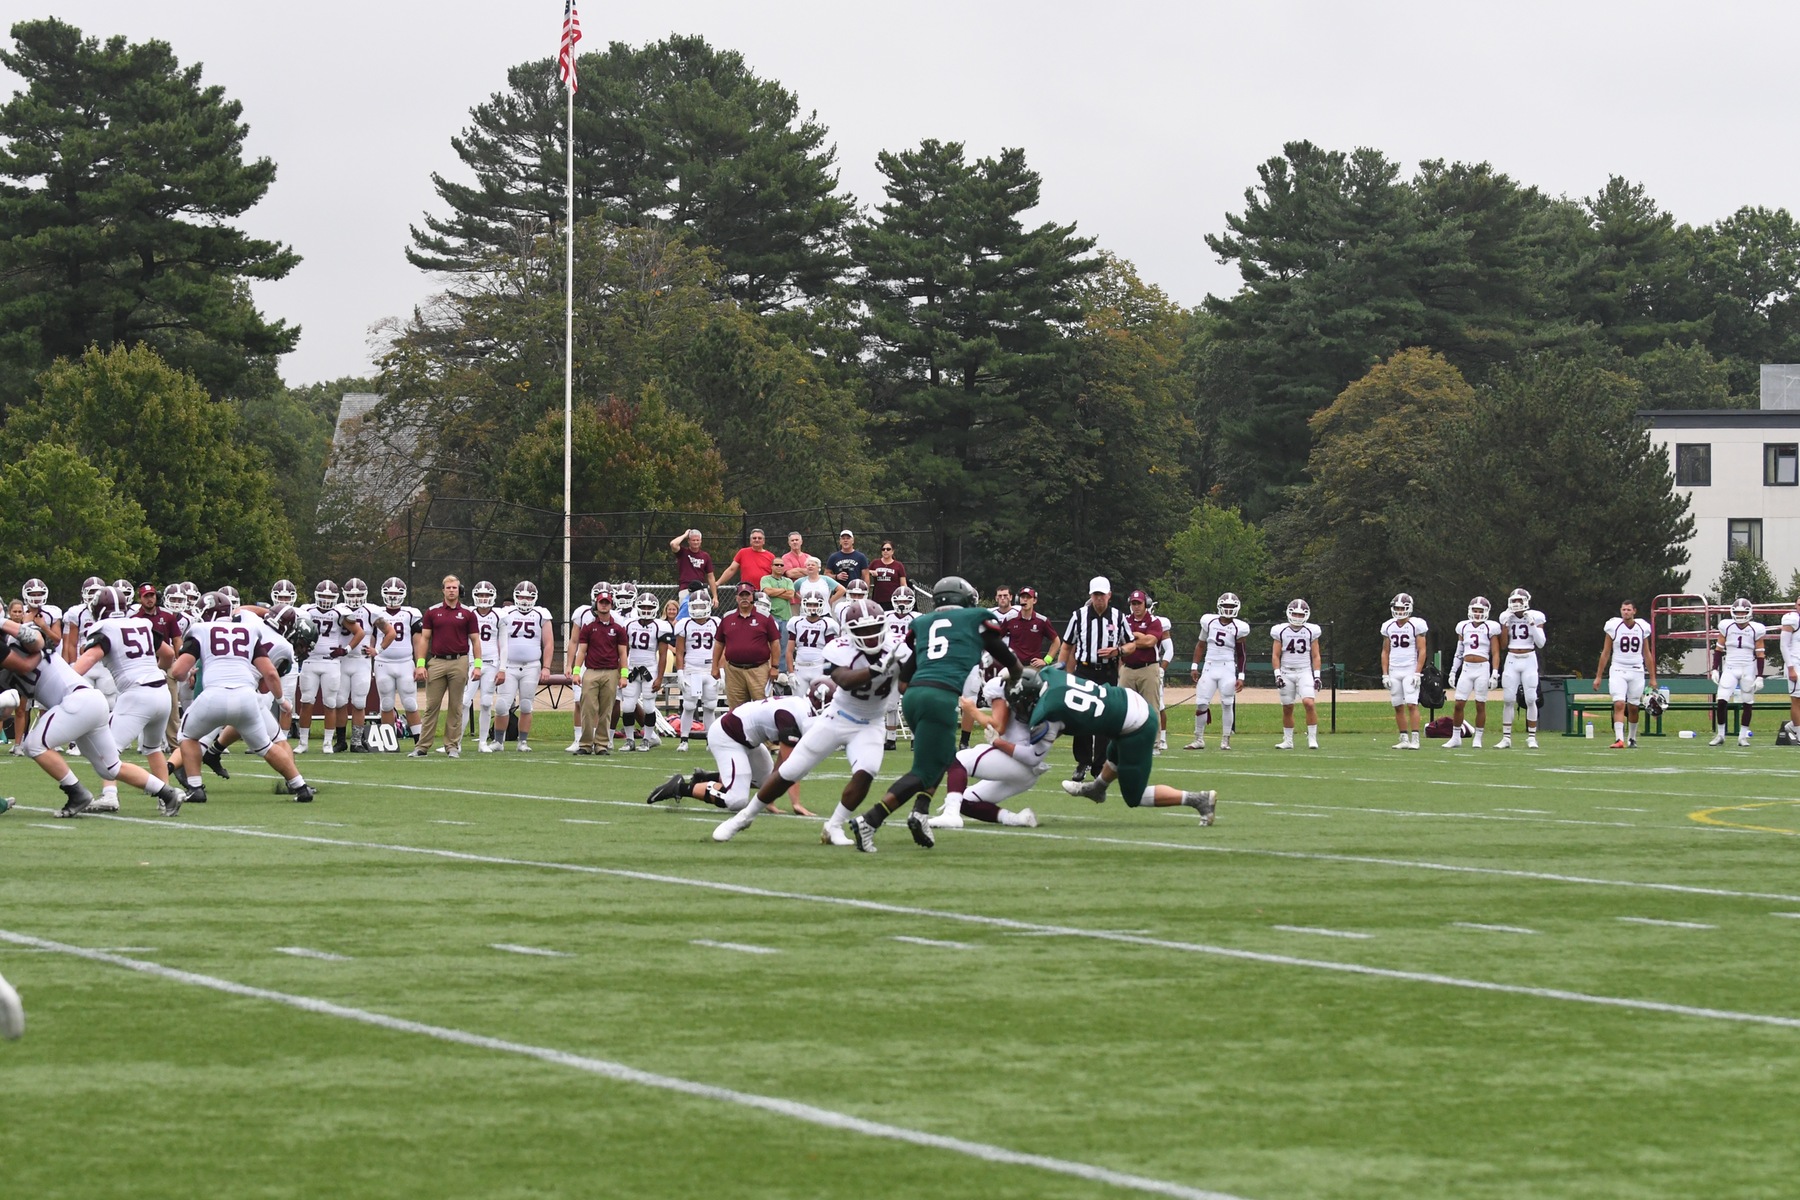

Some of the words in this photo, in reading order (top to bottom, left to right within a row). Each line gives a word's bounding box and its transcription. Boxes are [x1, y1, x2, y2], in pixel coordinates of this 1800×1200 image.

[510, 621, 535, 639] 75
[799, 629, 821, 648] 47
[1215, 631, 1226, 647] 5
[1511, 624, 1529, 640] 13
[120, 626, 154, 660] 57
[210, 626, 250, 660] 62
[631, 631, 650, 650] 19
[691, 632, 713, 650] 33
[927, 619, 953, 660] 6
[1286, 638, 1307, 654] 43
[1390, 634, 1410, 648] 36
[1470, 634, 1479, 649] 3
[1620, 636, 1640, 653] 89
[1736, 636, 1743, 649] 1
[1064, 673, 1107, 718] 95
[368, 724, 398, 752] 40
